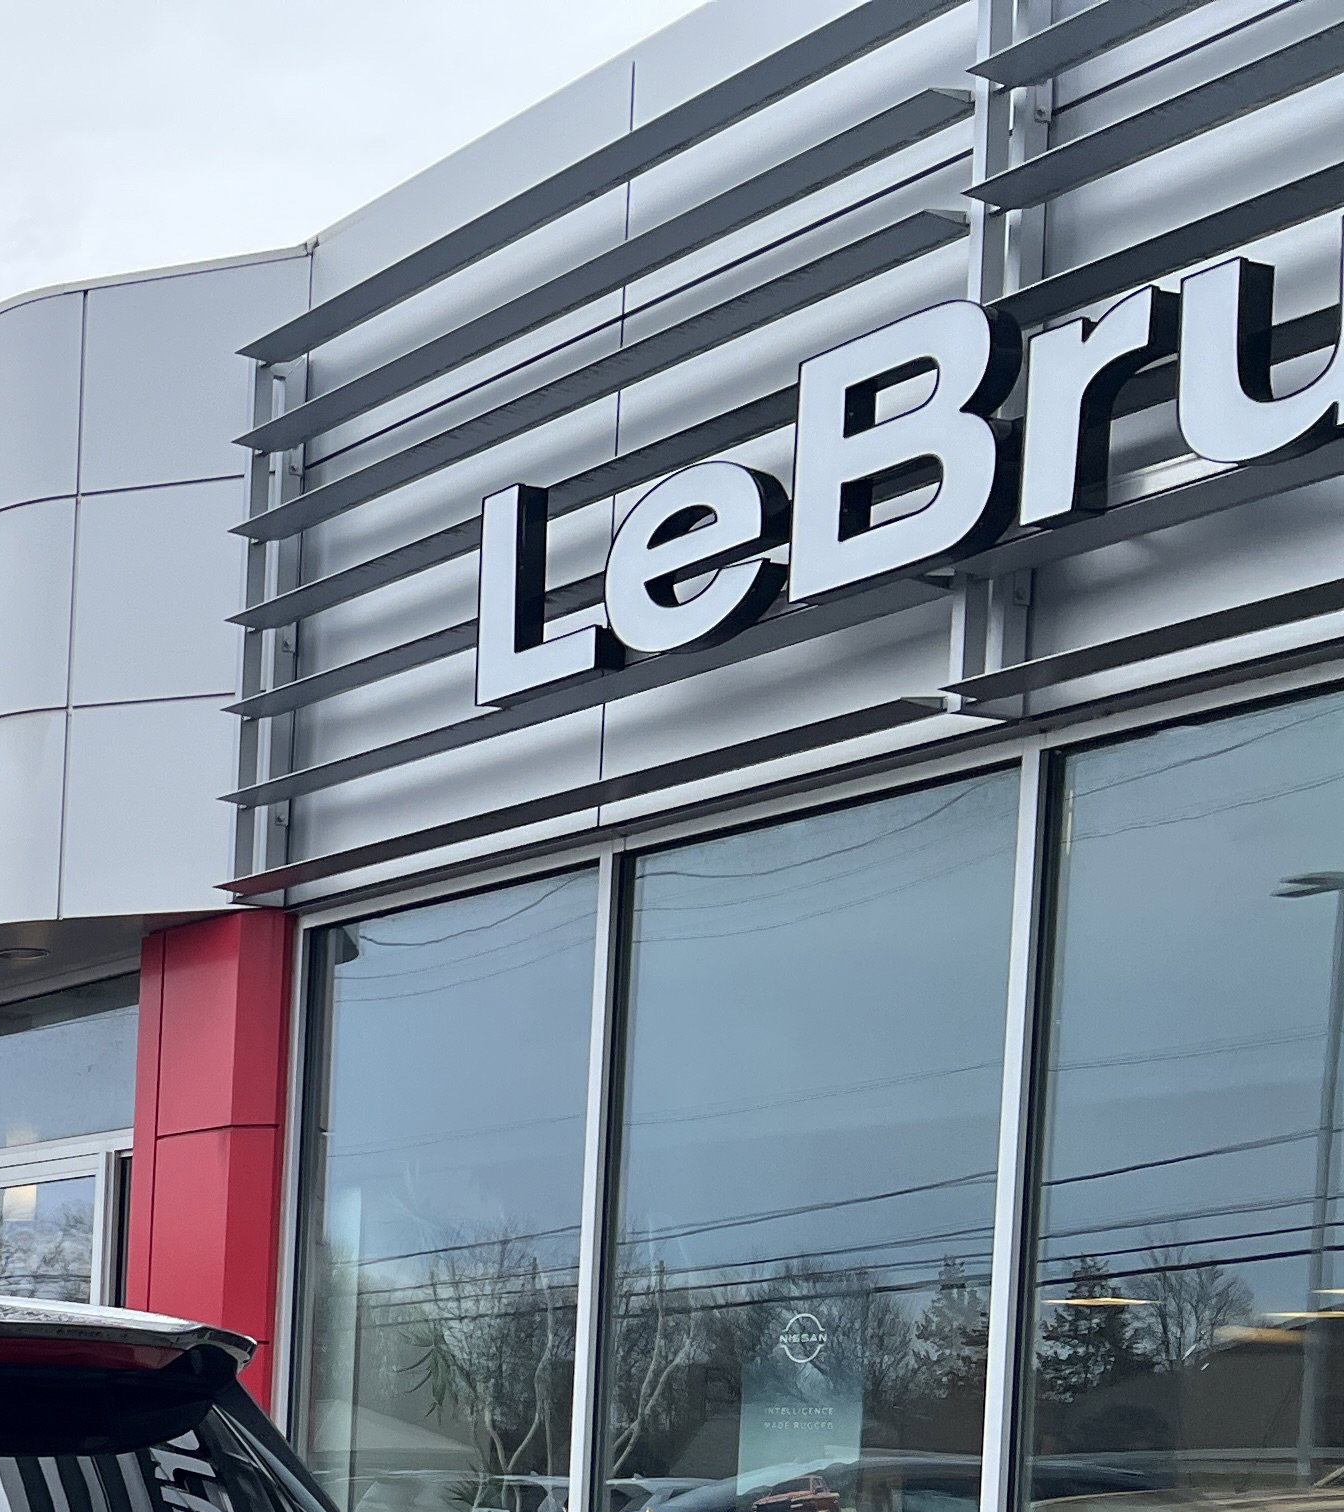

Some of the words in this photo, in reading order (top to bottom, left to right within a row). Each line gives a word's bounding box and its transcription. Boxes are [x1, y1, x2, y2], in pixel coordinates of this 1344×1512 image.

[475, 215, 1344, 706] LeBru
[779, 1332, 827, 1344] NISSAN
[765, 1407, 834, 1416] INTELLIGENCE
[764, 1421, 790, 1430] MADE
[793, 1421, 834, 1430] RUGGED
